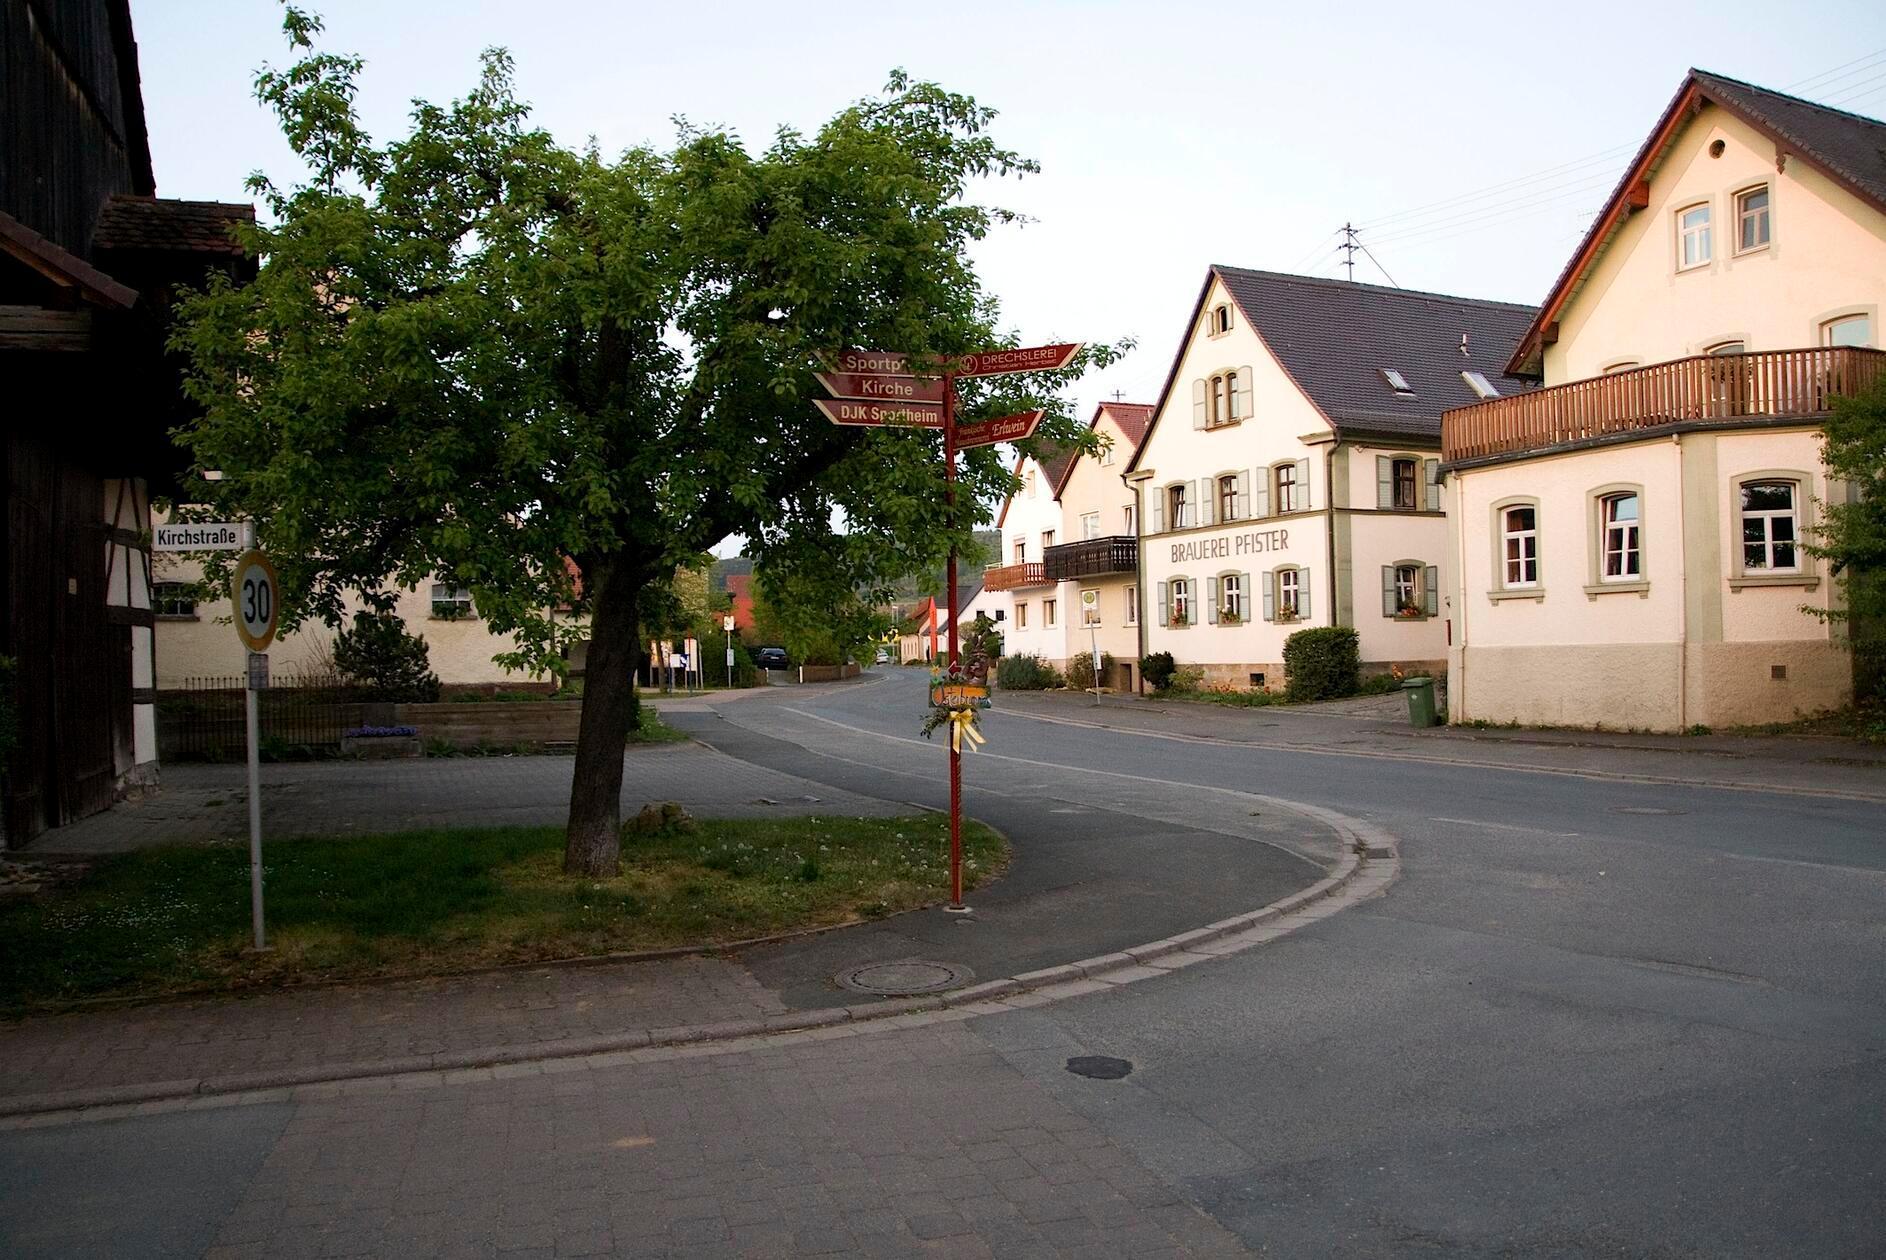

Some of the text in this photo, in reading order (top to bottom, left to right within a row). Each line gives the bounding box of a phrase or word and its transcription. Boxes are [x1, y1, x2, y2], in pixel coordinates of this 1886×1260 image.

[846, 355, 905, 373] Sportp
[982, 349, 1057, 365] DRECHSLEREI
[862, 380, 913, 395] Kirche
[841, 405, 868, 420] DJK
[992, 419, 1025, 437] Erlwein
[157, 528, 237, 546] Kirchstraße
[1171, 529, 1289, 563] BRAUEREI PFISTER
[243, 578, 270, 624] 30
